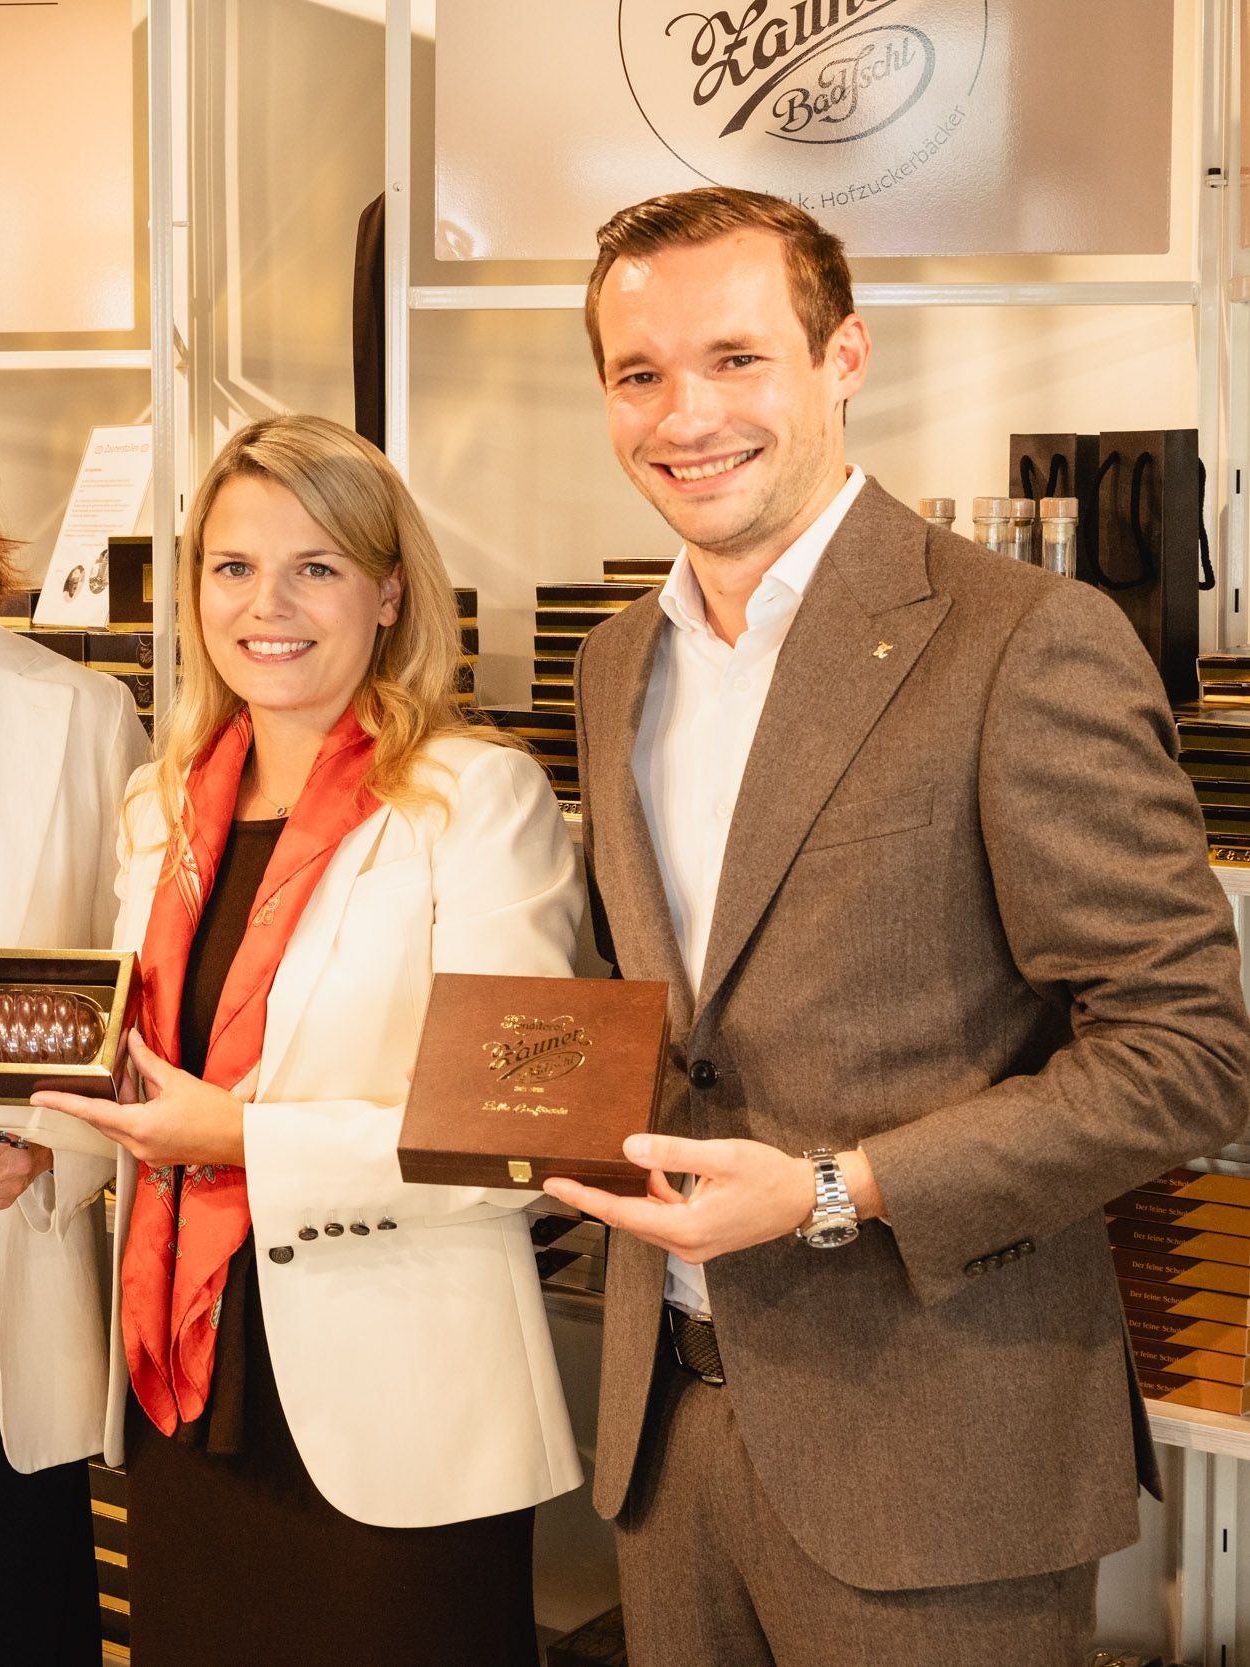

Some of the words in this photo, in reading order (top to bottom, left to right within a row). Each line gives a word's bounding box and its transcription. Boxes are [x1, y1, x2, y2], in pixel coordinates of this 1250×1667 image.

[822, 105, 966, 208] Hofzuckerbäcker
[1149, 1204, 1167, 1214] feine
[1133, 1231, 1145, 1240] Der
[1147, 1233, 1165, 1242] feine
[1146, 1262, 1163, 1272] feine
[1130, 1290, 1142, 1298] Der
[1144, 1291, 1161, 1301] feine
[1129, 1319, 1141, 1327] Der
[1143, 1320, 1160, 1330] feine
[1140, 1350, 1158, 1359] feine
